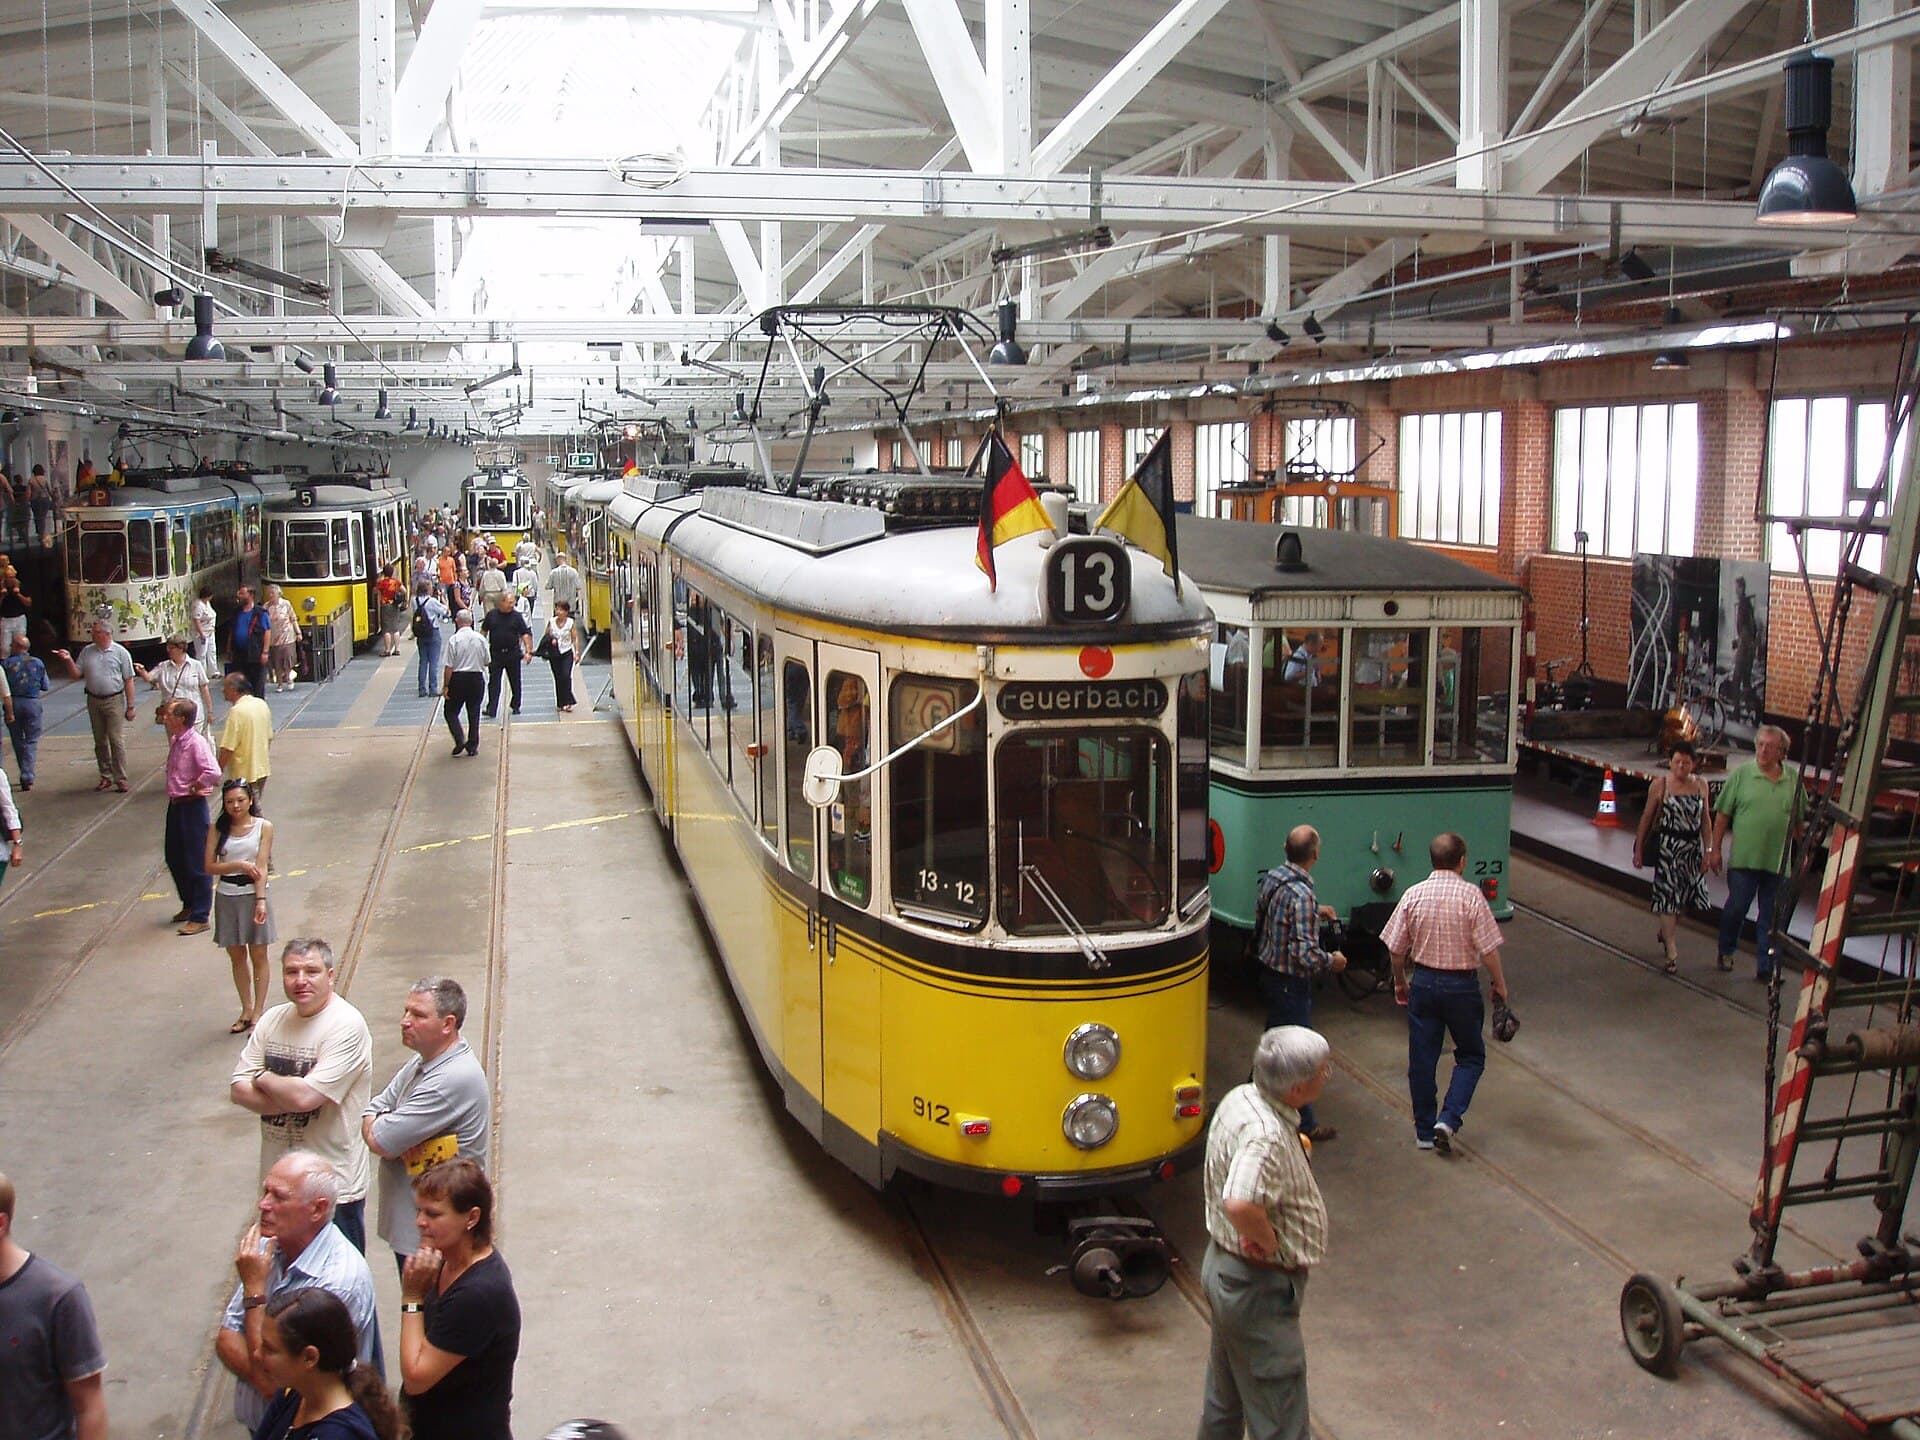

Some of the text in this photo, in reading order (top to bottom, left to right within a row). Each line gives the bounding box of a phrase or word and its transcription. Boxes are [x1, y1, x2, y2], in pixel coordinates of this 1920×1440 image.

[96, 490, 106, 505] P
[301, 491, 312, 506] 5
[1061, 551, 1114, 611] 13
[1475, 860, 1503, 875] 23
[919, 868, 975, 904] 13 12
[913, 1095, 950, 1126] 912
